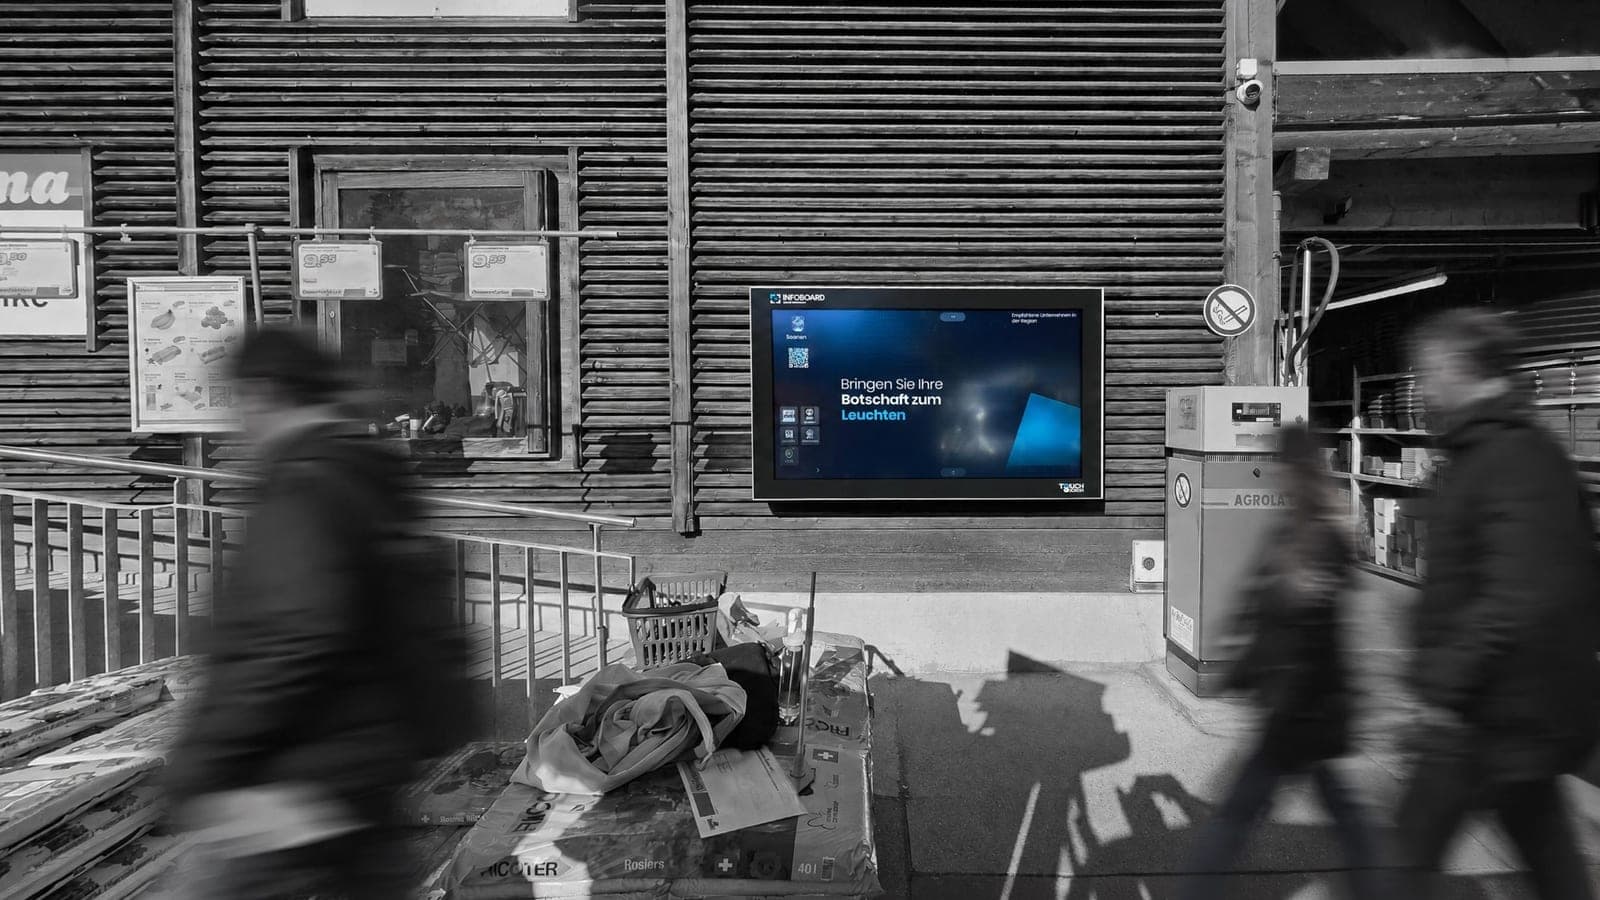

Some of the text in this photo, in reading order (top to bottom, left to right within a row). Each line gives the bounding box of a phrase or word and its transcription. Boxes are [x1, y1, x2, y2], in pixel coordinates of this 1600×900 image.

[782, 293, 826, 302] INFOBOARD
[840, 377, 944, 393] Bringen Sie Ihre
[841, 393, 942, 406] Botschaft zum
[841, 409, 907, 421] Leuchten
[1234, 494, 1286, 507] AGROLA
[624, 858, 666, 871] Rosiers
